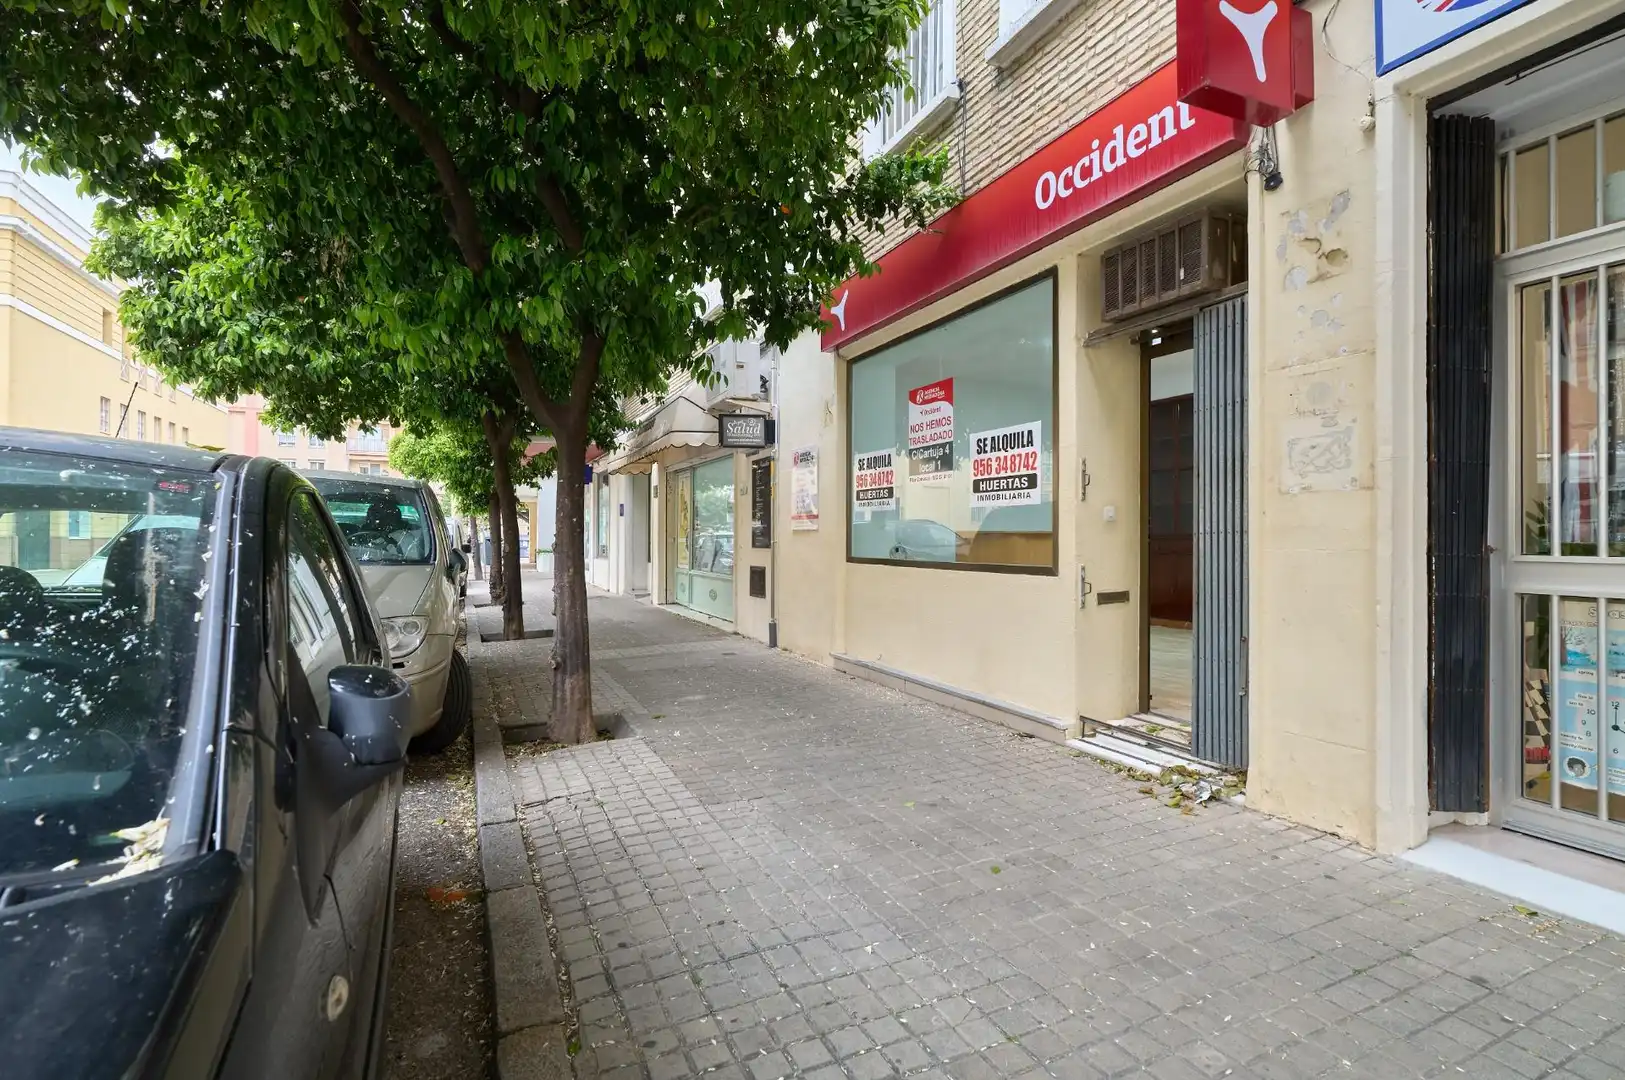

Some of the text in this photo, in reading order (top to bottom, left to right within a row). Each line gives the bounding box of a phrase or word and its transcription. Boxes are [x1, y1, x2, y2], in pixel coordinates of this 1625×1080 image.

[1035, 101, 1196, 210] Occident
[910, 416, 952, 434] NOS HEMOS
[909, 429, 953, 446] TRASLADADO
[976, 429, 1034, 456] SE ALQUILA
[945, 443, 950, 455] 4
[857, 453, 892, 472] SE ALQUILA
[919, 459, 941, 473] local 1
[973, 457, 993, 478] 956
[855, 474, 868, 489] 956
[980, 477, 1029, 491] HUERTAS
[859, 489, 889, 500] HUERTAS
[977, 492, 1032, 502] INMOBILIARIA
[1587, 708, 1596, 716] 10
